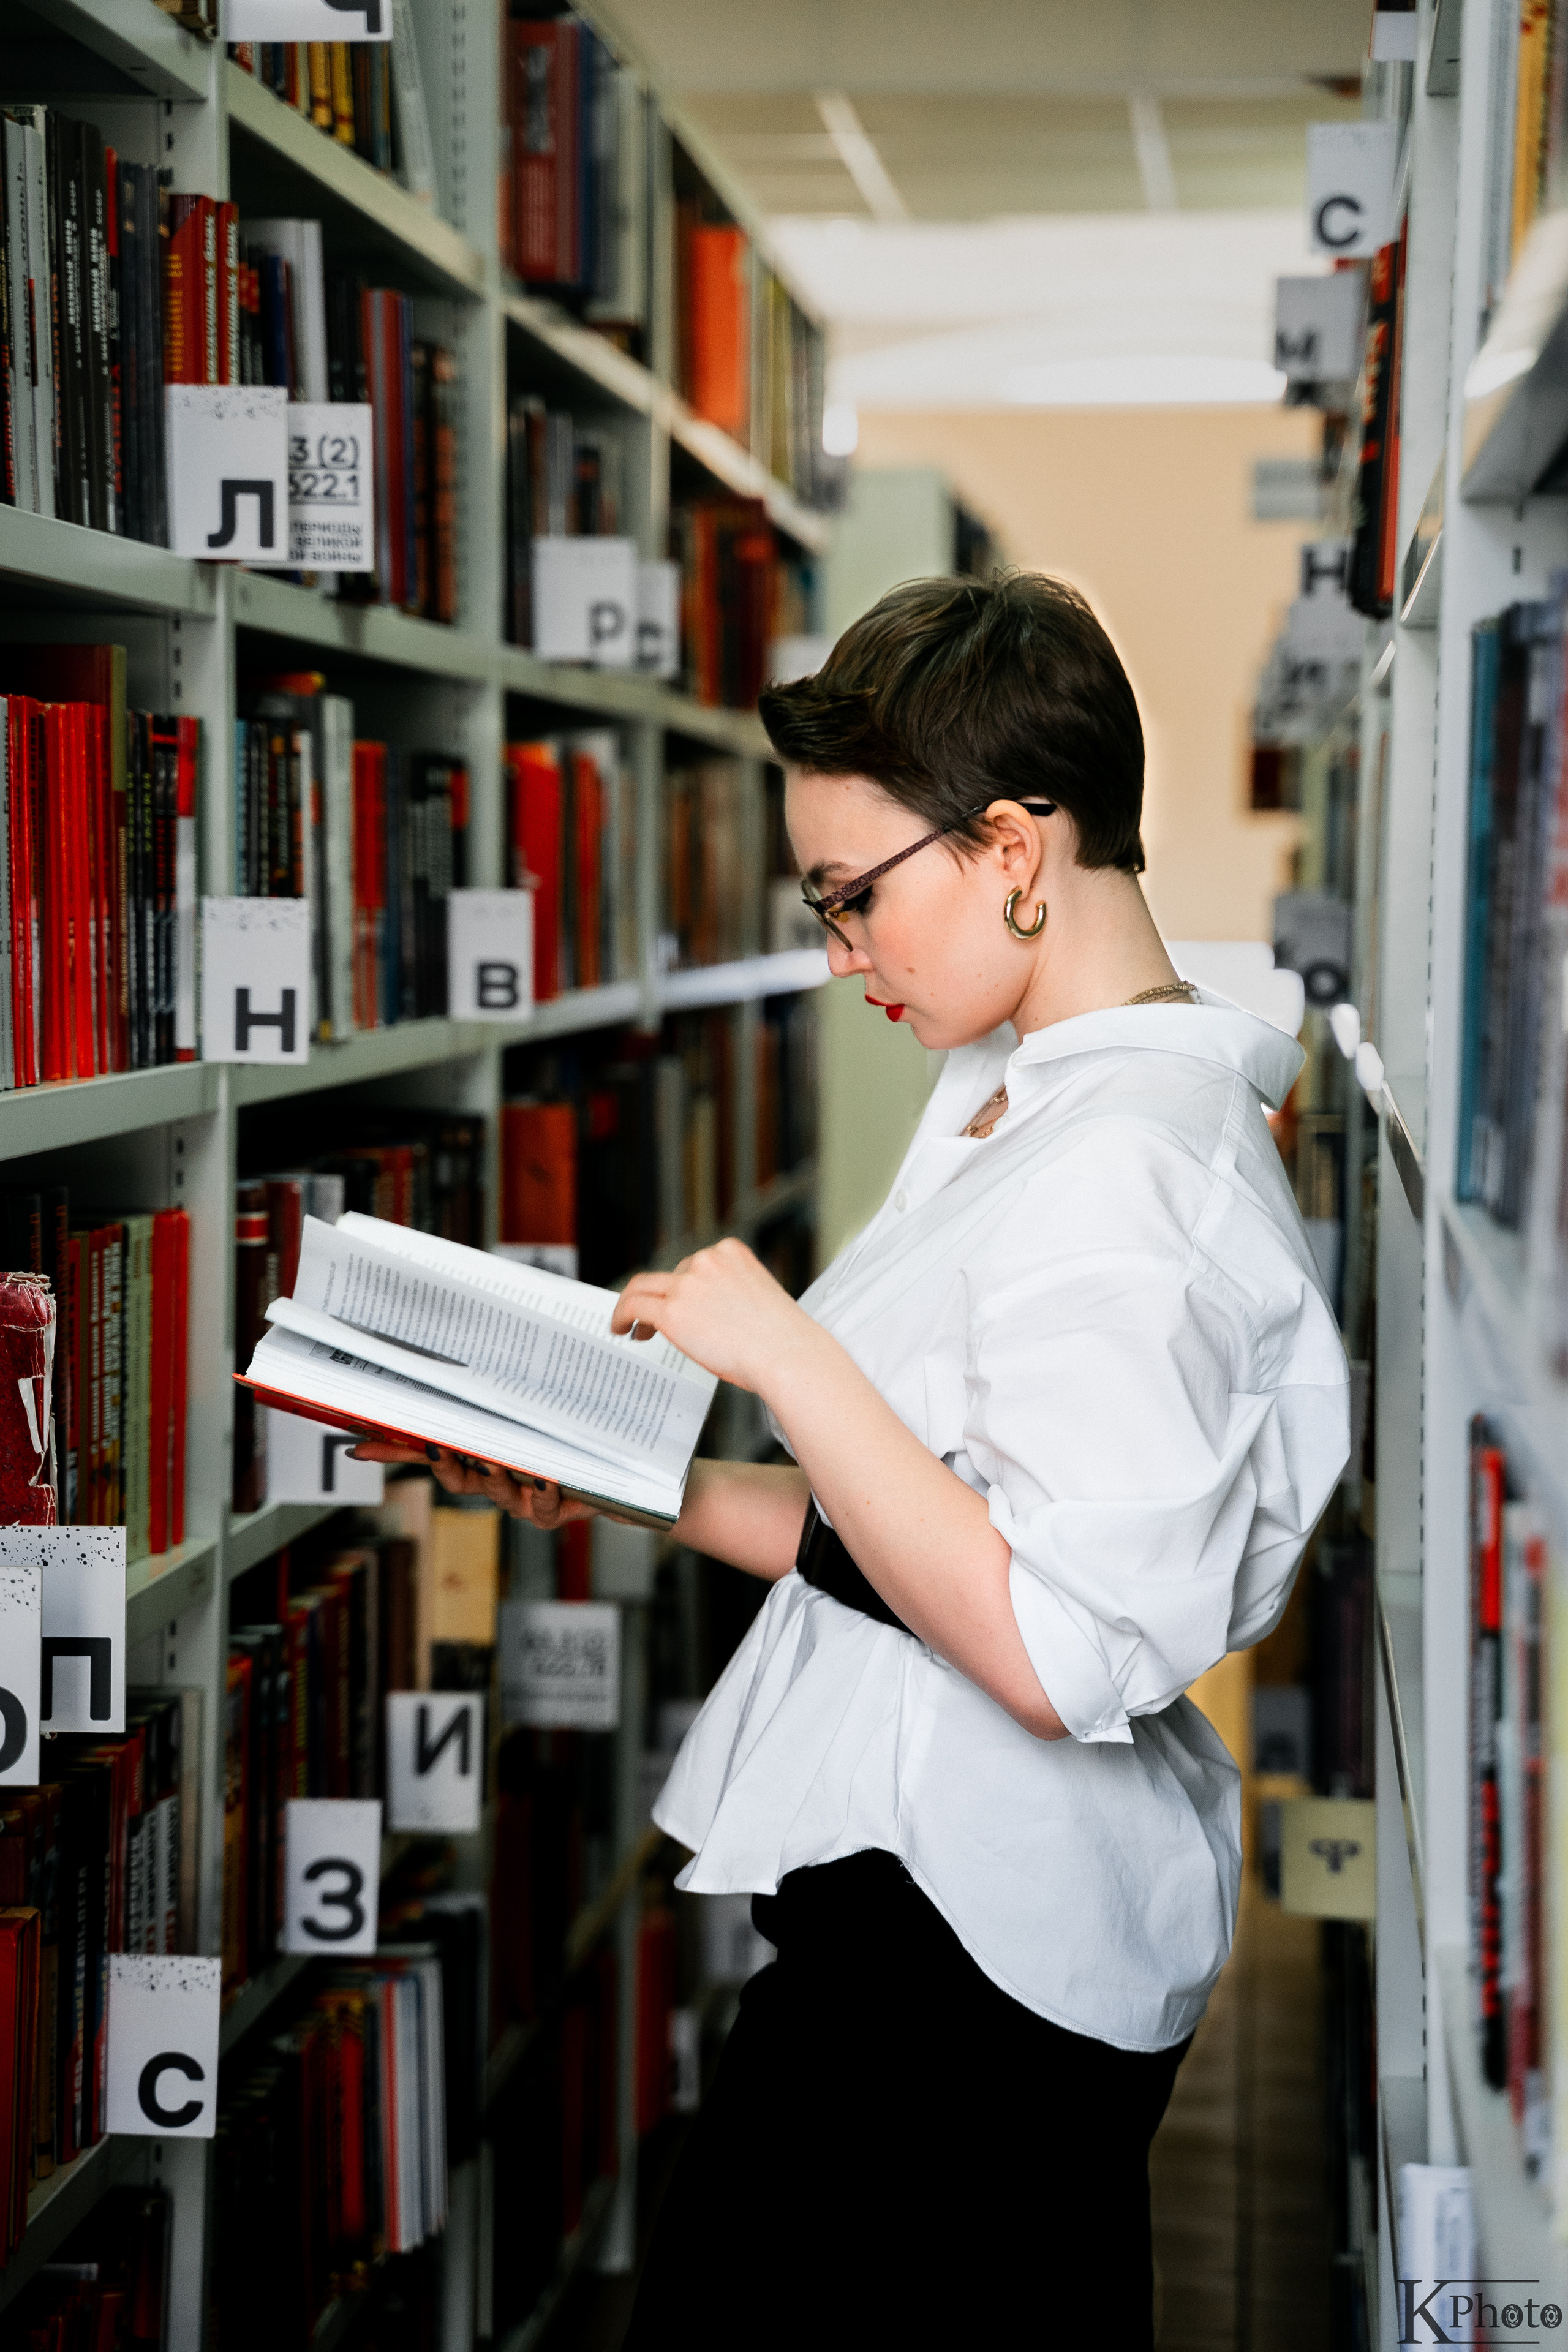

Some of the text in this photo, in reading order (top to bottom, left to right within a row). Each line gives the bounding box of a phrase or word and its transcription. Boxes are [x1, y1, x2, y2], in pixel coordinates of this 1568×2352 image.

[1316, 196, 1360, 248] С
[207, 480, 274, 548] Л
[477, 963, 518, 1008] В
[235, 987, 295, 1052] Н
[322, 1434, 364, 1492] Г
[42, 1637, 111, 1721] П
[417, 1705, 469, 1776] И
[138, 2051, 205, 2128] С
